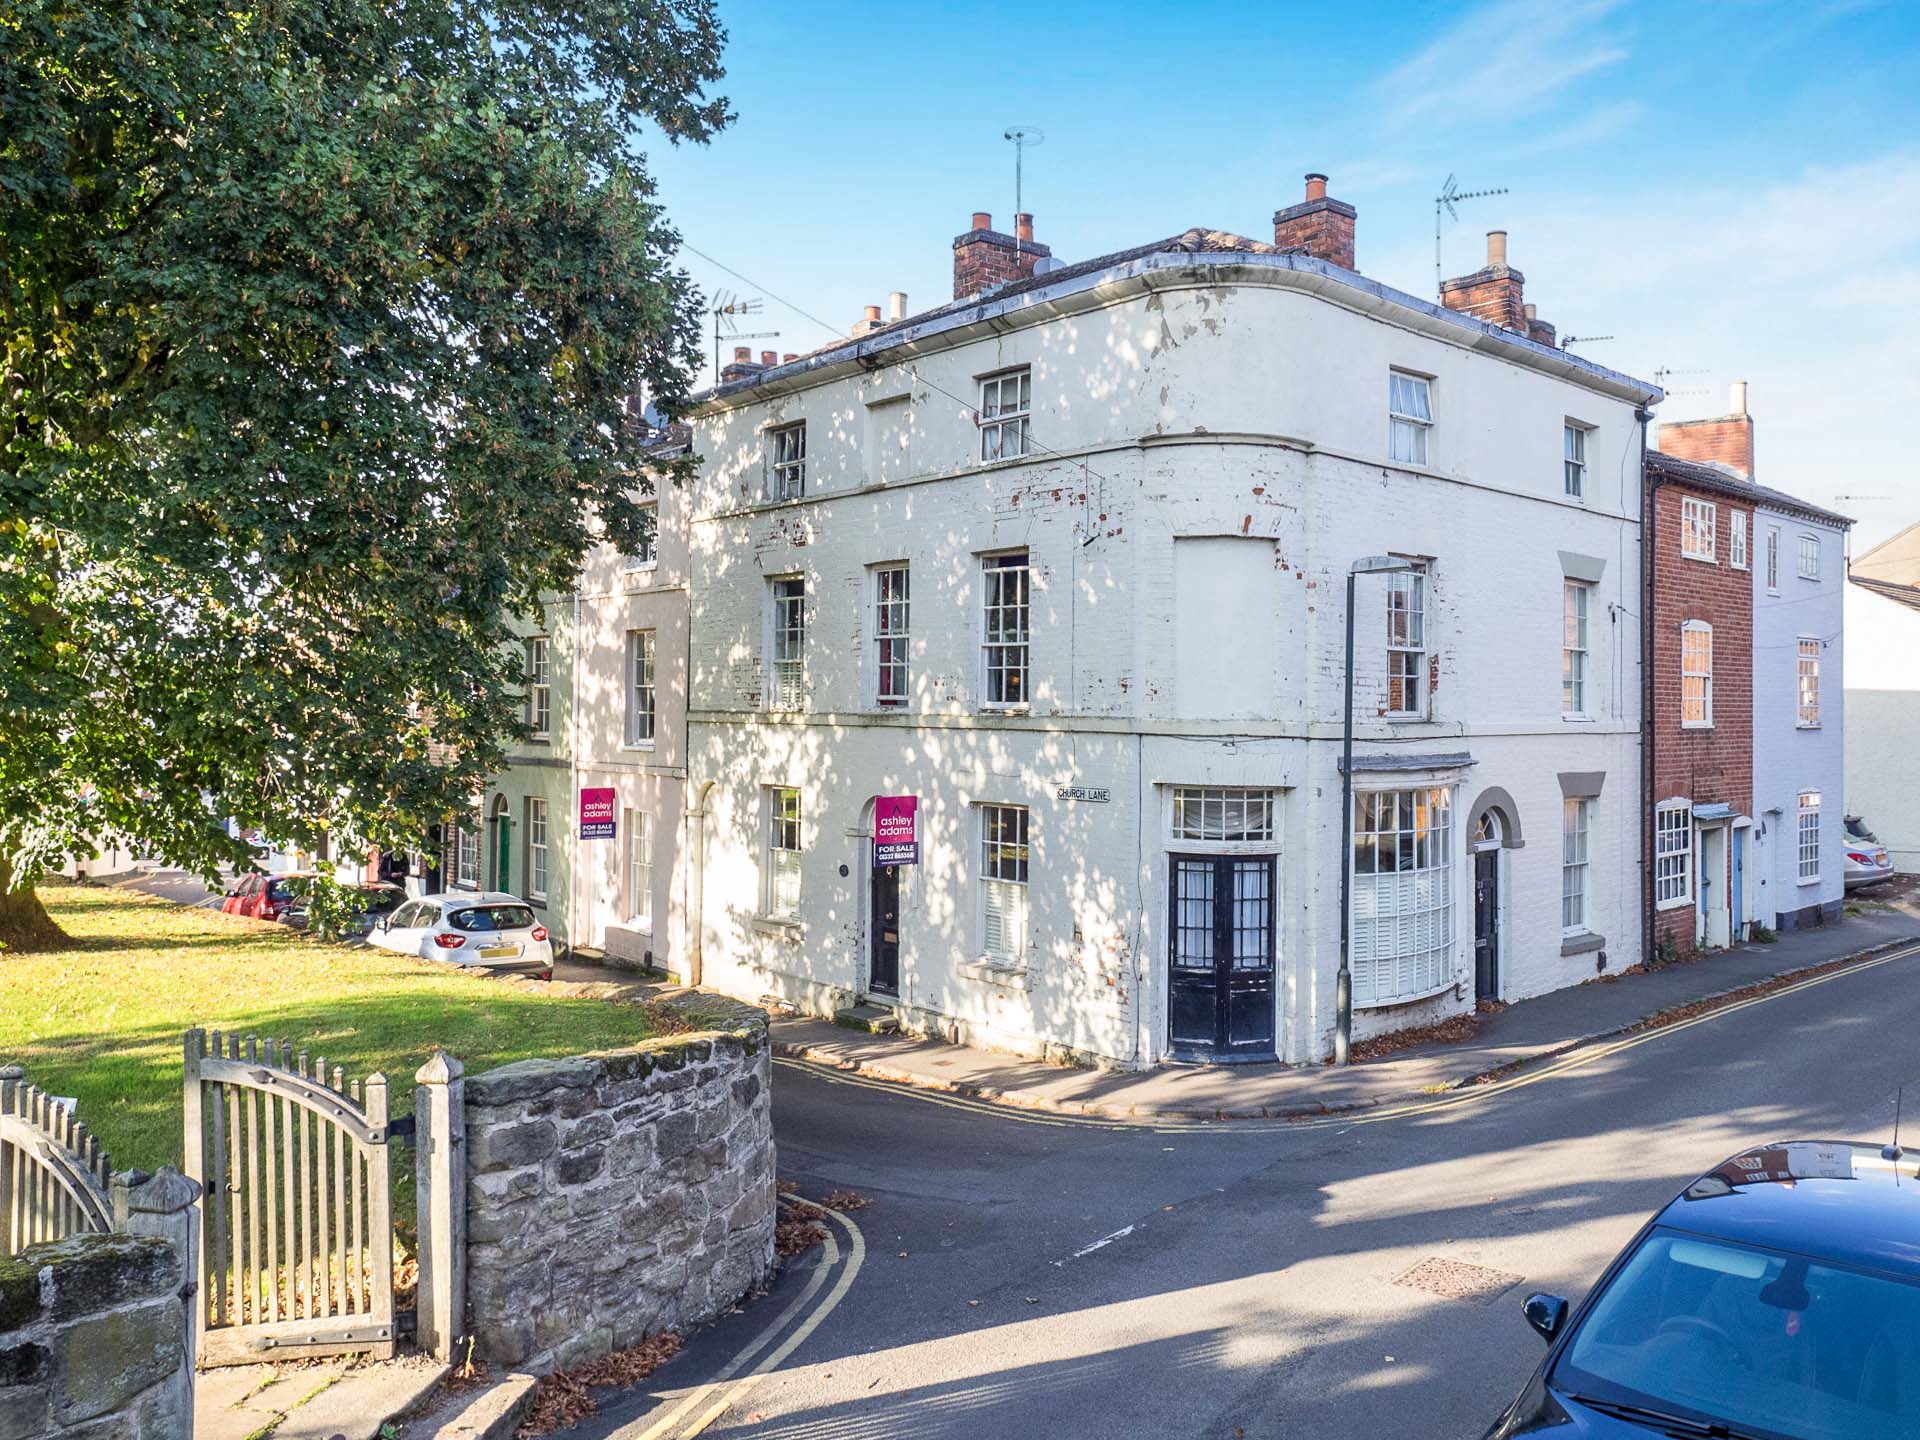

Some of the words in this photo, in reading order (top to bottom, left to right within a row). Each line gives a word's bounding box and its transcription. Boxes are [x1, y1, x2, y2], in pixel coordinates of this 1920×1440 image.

[1057, 788, 1085, 799] CHURCH
[1088, 790, 1108, 800] LANE
[585, 802, 612, 810] ashley
[881, 816, 912, 826] ashley
[880, 826, 913, 836] adams
